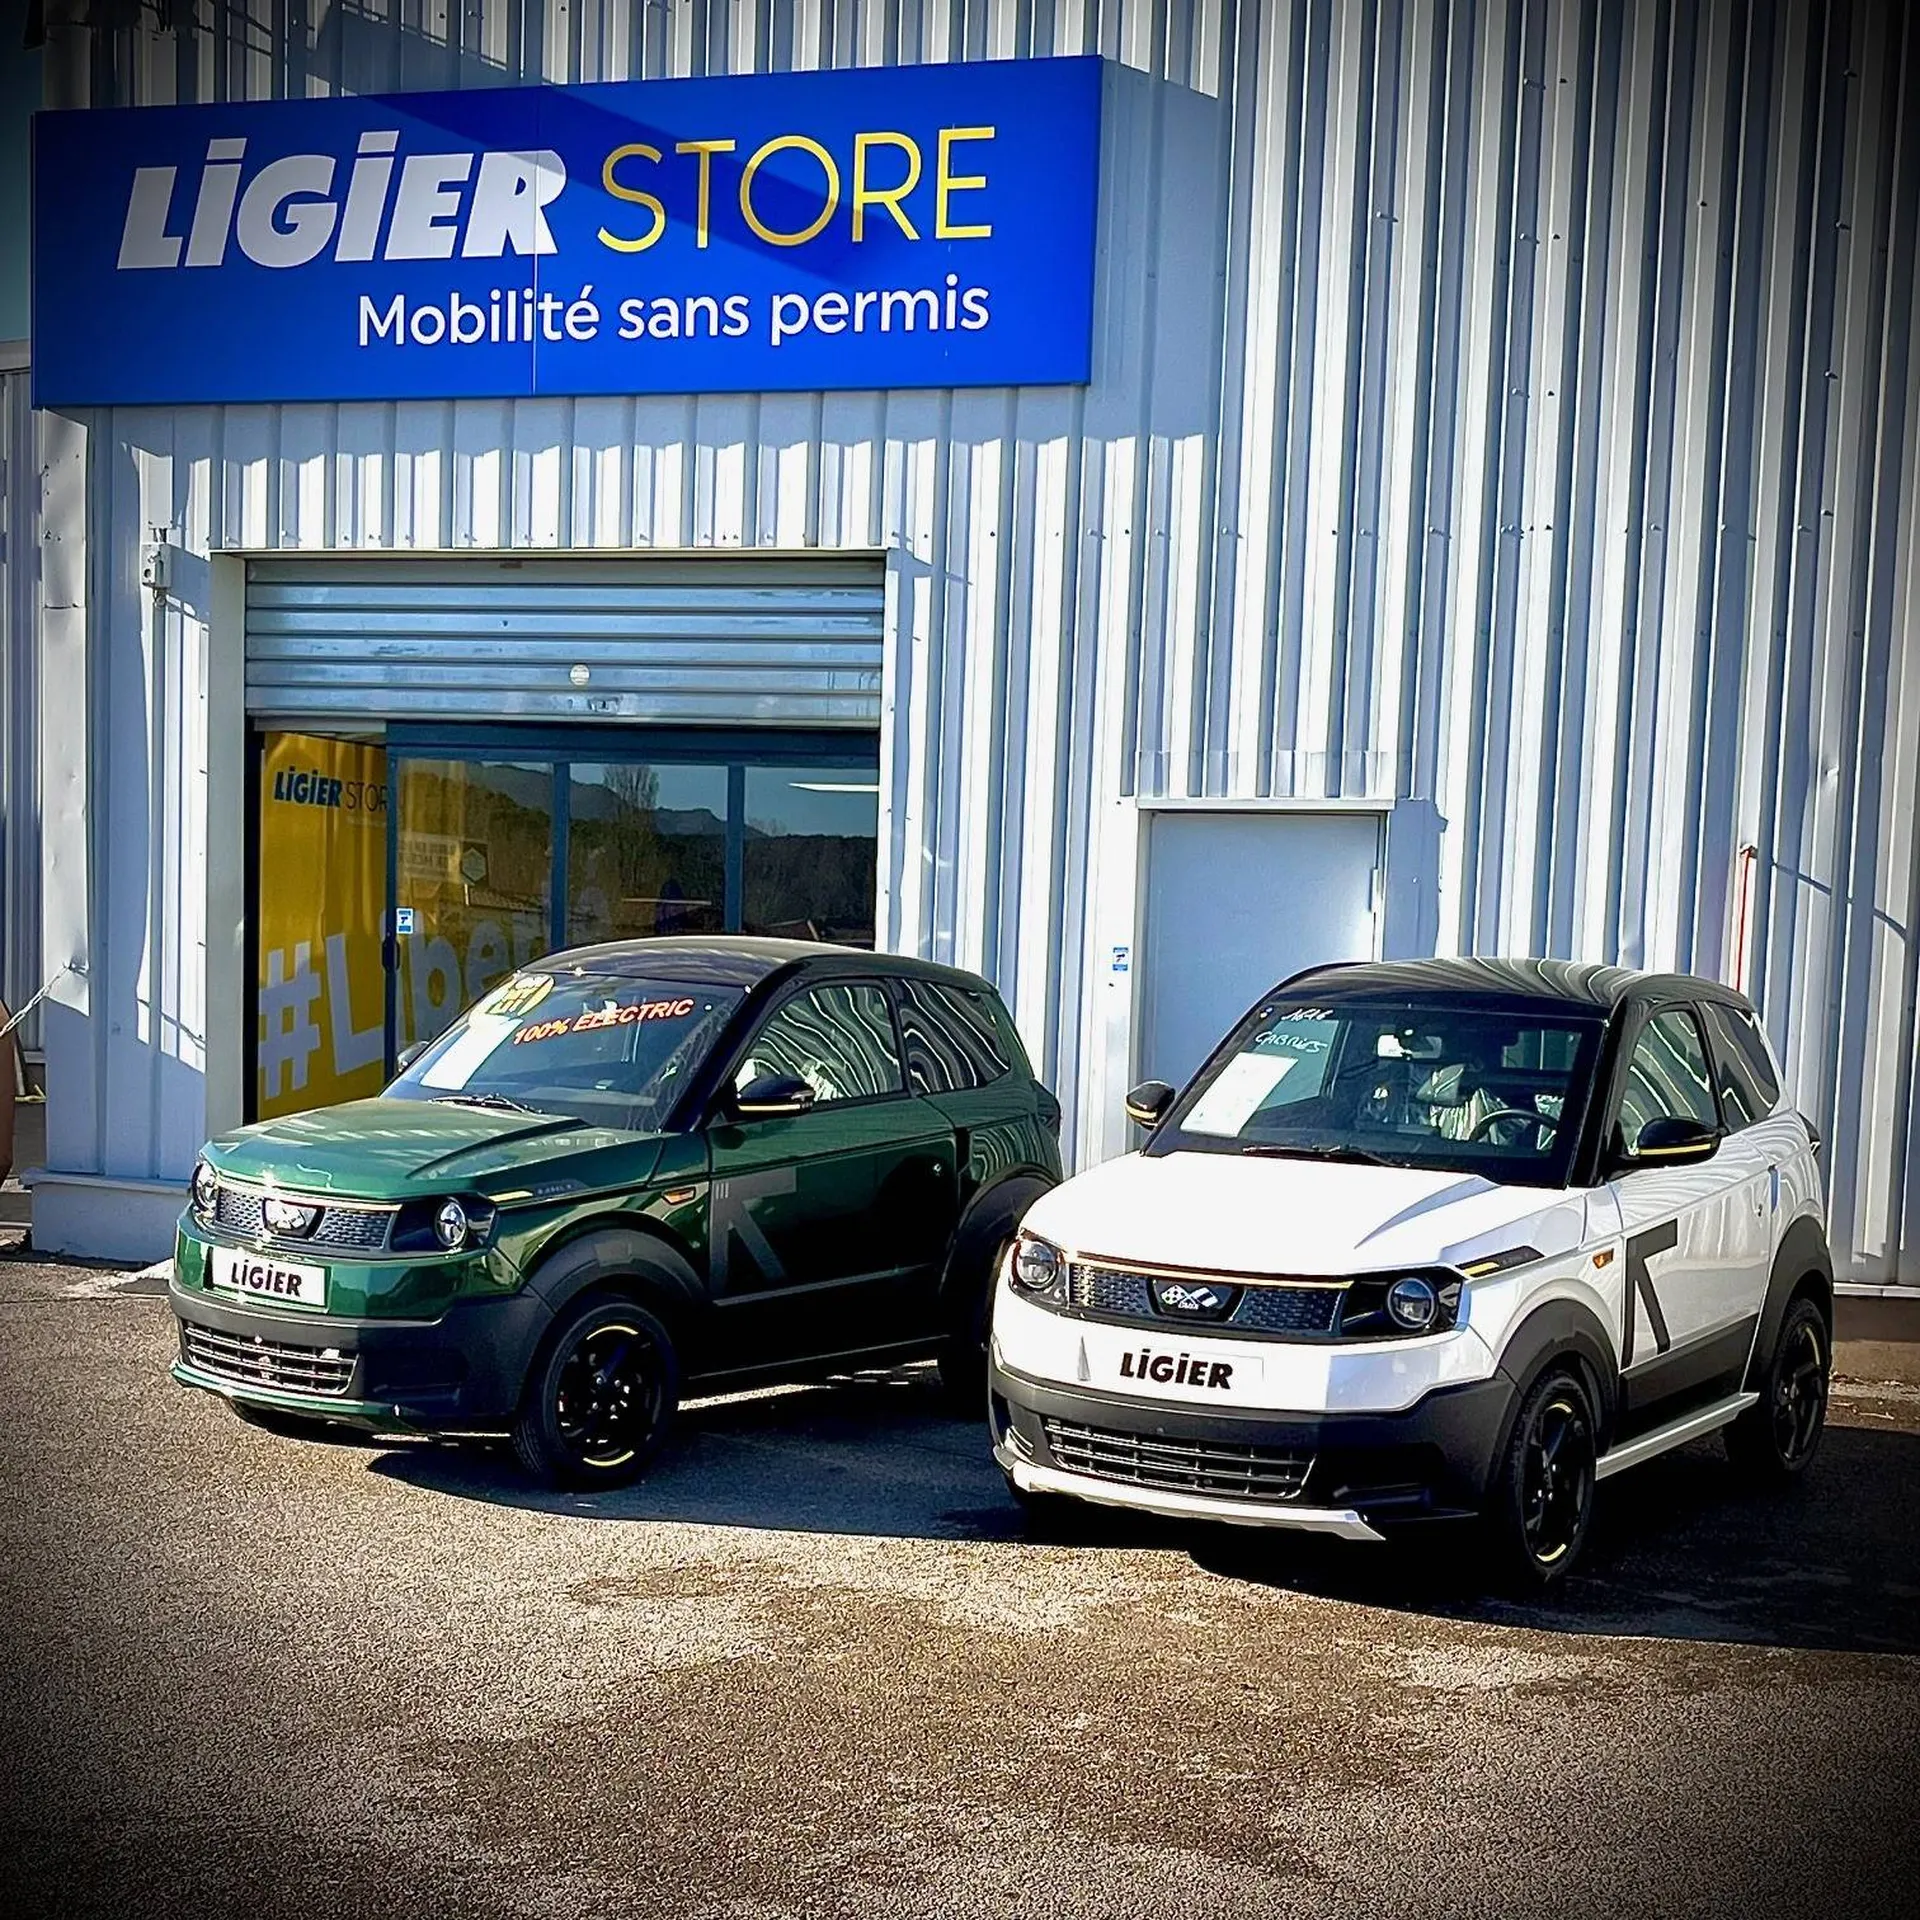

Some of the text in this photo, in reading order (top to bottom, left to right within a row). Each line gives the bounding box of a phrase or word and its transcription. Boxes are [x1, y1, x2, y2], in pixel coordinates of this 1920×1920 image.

[597, 126, 997, 253] STORE
[358, 273, 990, 347] Mobilité sans permis
[345, 781, 388, 812] STOR
[513, 999, 695, 1045] 100% ELECTRIC
